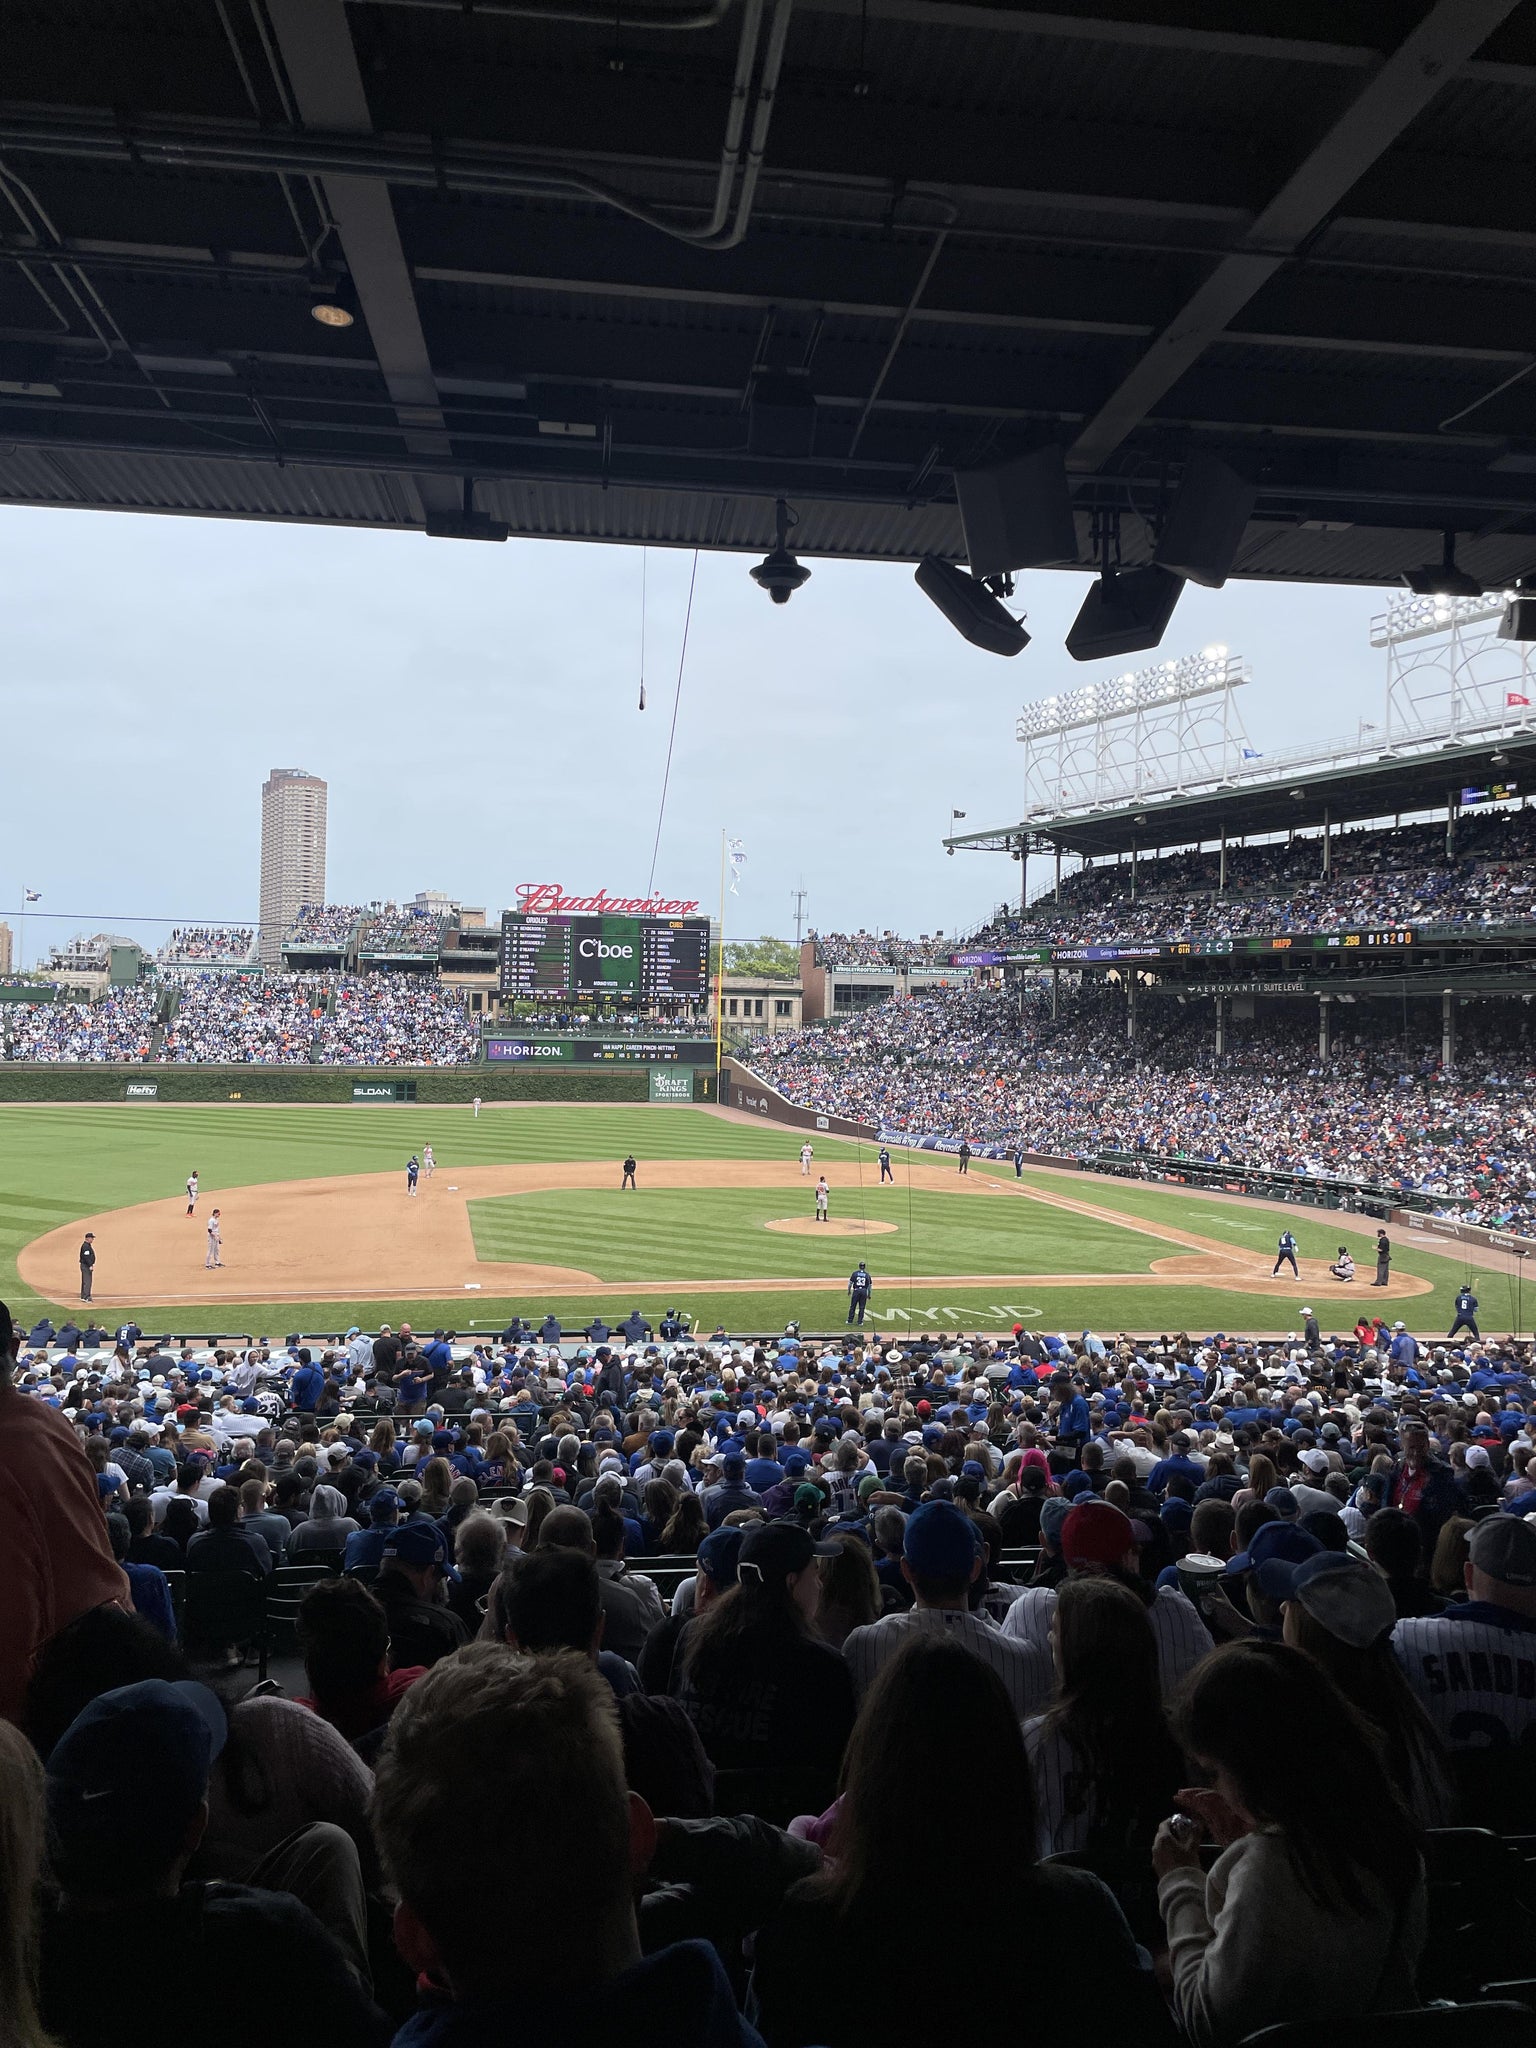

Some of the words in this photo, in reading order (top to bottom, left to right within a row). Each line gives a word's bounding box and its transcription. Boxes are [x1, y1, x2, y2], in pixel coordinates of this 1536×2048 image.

[515, 884, 699, 914] Budweiser
[1206, 942, 1210, 952] 2
[1228, 941, 1233, 952] 3
[1272, 939, 1292, 948] HAPP
[1328, 938, 1340, 946] AVG
[130, 1086, 154, 1094] Hefty
[856, 1277, 866, 1286] 33
[1462, 1300, 1467, 1309] 6
[856, 1305, 1043, 1321] MYND
